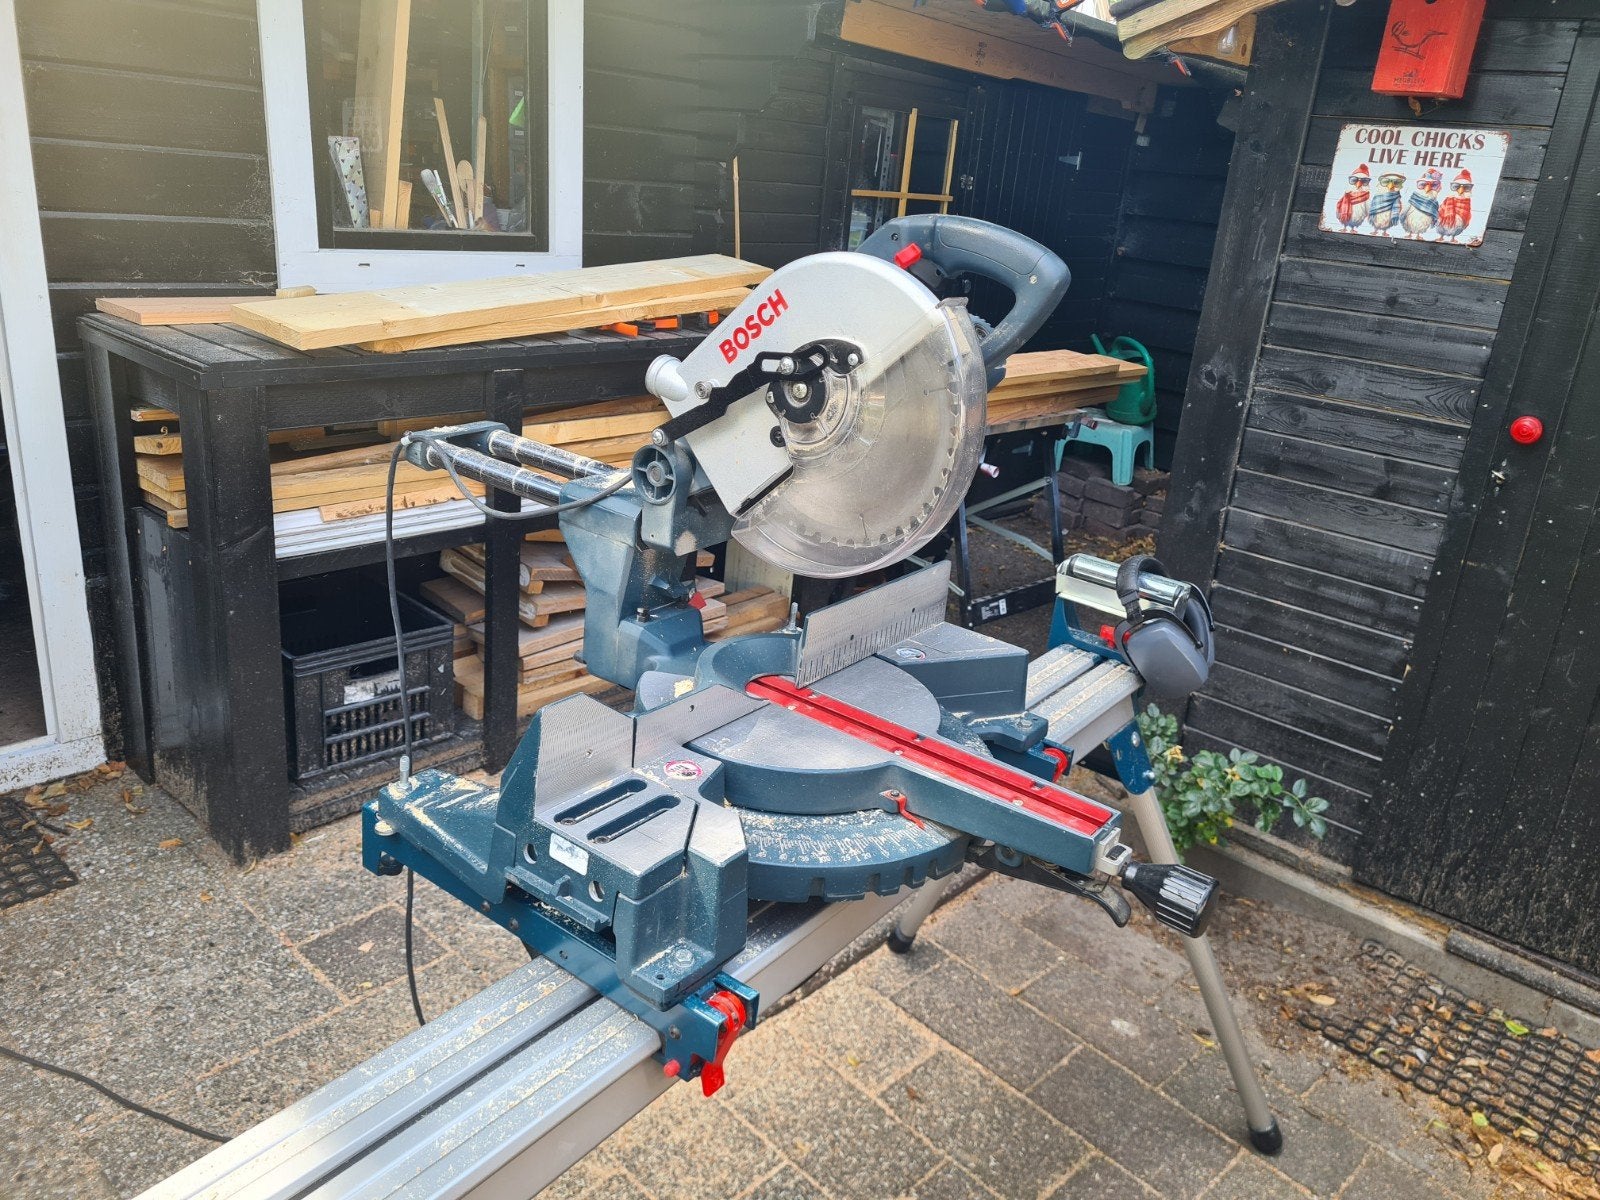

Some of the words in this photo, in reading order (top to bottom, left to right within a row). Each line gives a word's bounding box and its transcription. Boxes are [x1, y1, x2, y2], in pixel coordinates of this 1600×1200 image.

[1354, 128, 1404, 146] COOL
[1411, 130, 1486, 151] CHICKS
[1368, 147, 1409, 165] LIVE
[1413, 150, 1467, 169] HERE
[718, 288, 789, 364] BOSCH
